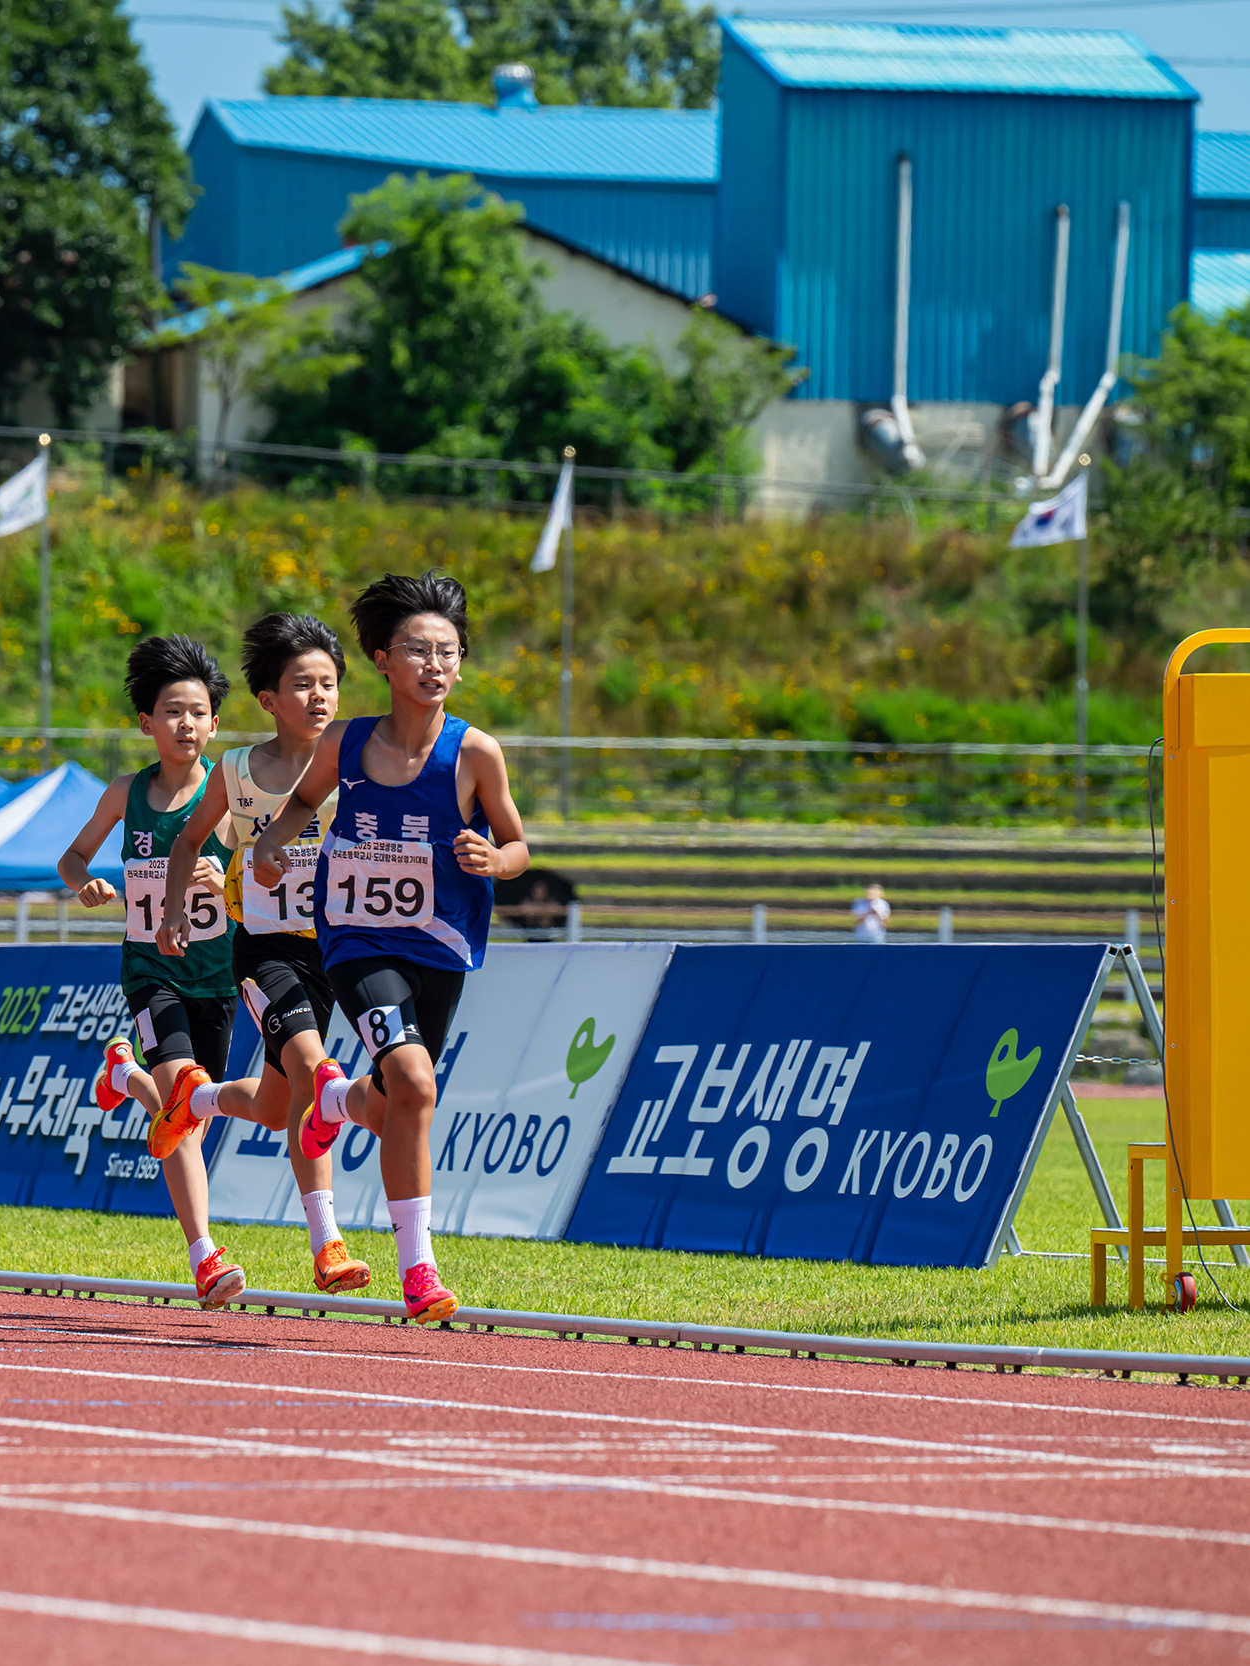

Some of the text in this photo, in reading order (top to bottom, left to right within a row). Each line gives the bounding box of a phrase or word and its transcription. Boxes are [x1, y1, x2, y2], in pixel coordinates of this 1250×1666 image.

[237, 797, 254, 807] T&F
[354, 812, 430, 842] 충북
[354, 842, 372, 850] 2025
[149, 860, 166, 869] 2025
[269, 881, 314, 921] 13
[338, 875, 425, 917] 159
[368, 1008, 391, 1049] 8
[606, 1039, 994, 1203] 교보생명 KYOBO
[435, 1111, 571, 1178] KYOBO
[104, 1152, 160, 1180] Since 1985
